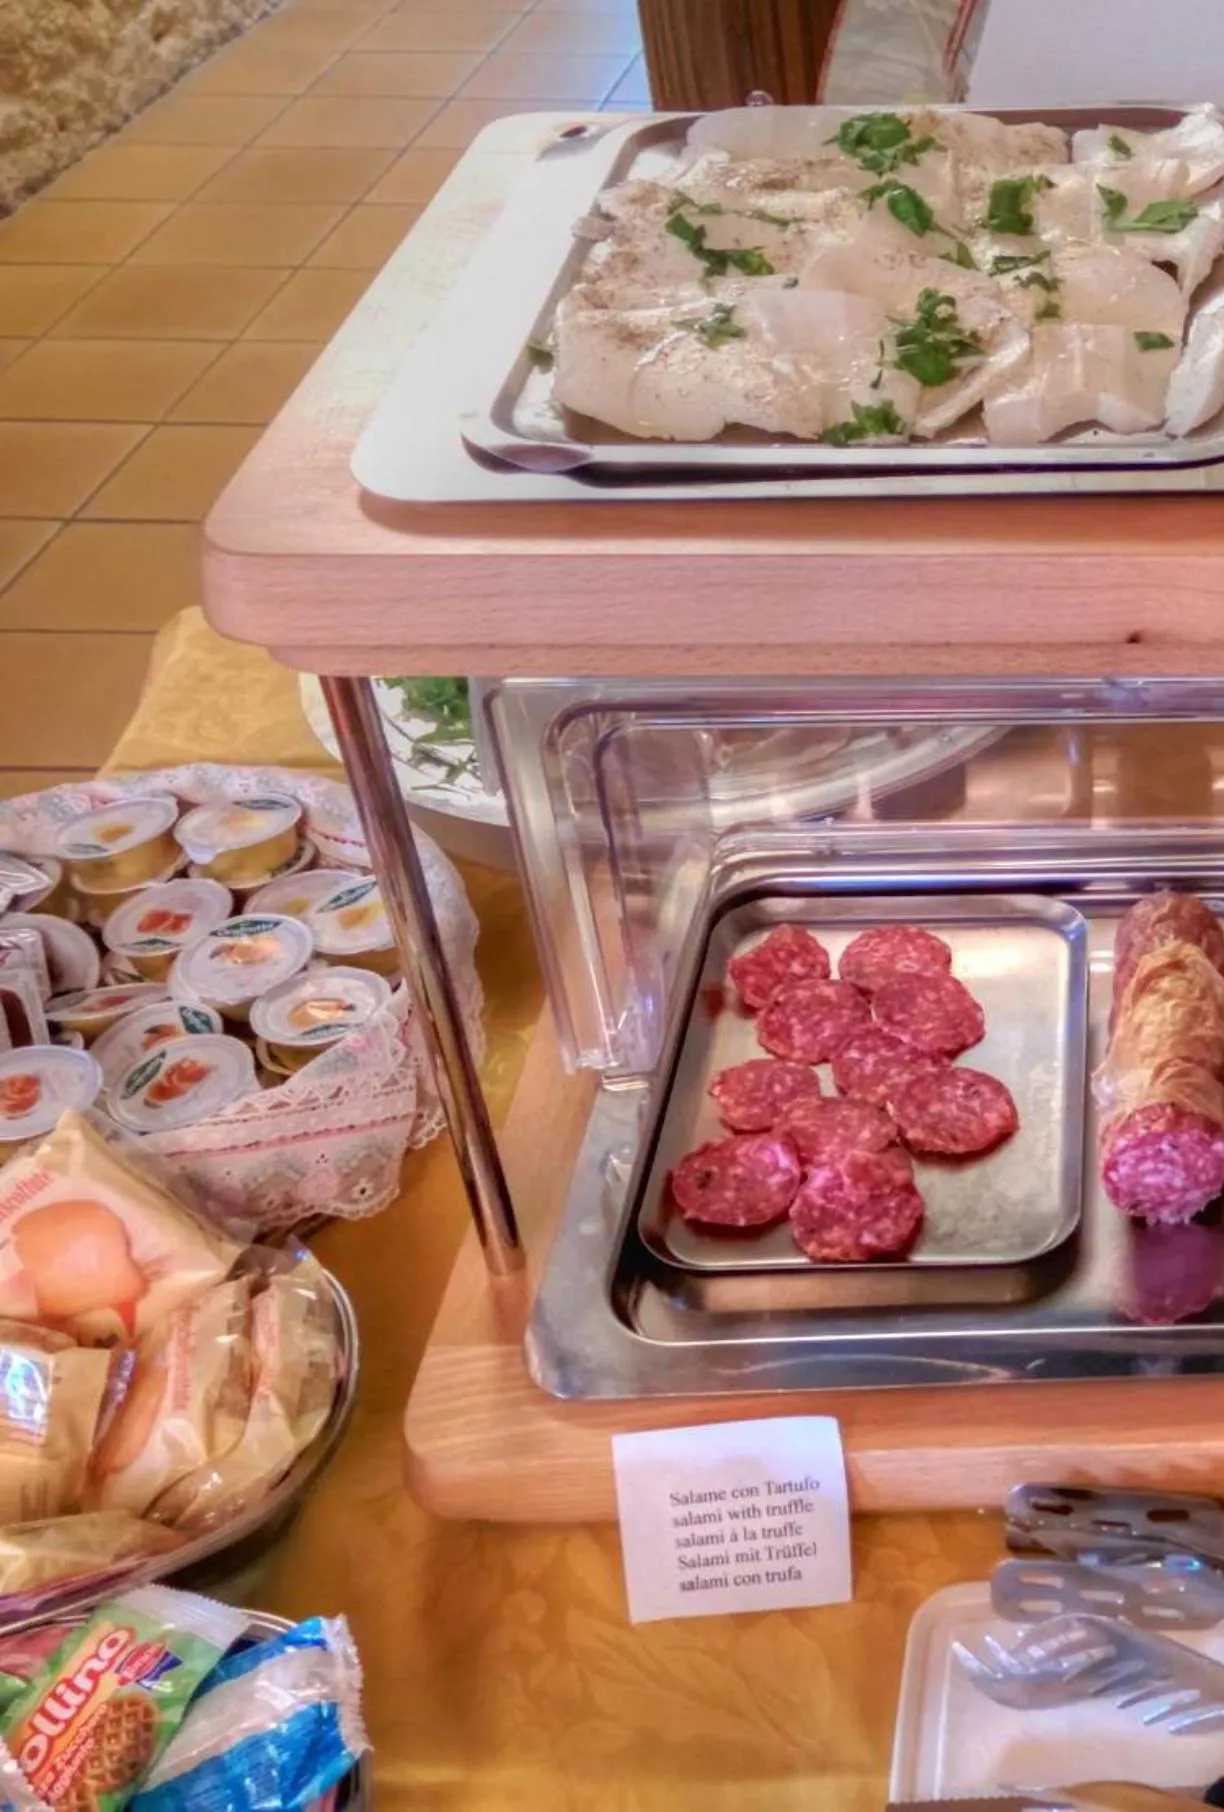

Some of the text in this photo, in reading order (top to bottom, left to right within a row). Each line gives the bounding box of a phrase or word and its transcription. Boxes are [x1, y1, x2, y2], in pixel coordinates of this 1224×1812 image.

[669, 1475, 820, 1506] Salame con Tartufo
[673, 1498, 814, 1528] salami with truffle
[675, 1530, 725, 1549] salami
[743, 1525, 757, 1541] la
[762, 1521, 803, 1539] truffe
[678, 1541, 817, 1570] Salami mit Trüffel
[679, 1565, 802, 1592] salami con trufa
[20, 1630, 128, 1773] ollino
